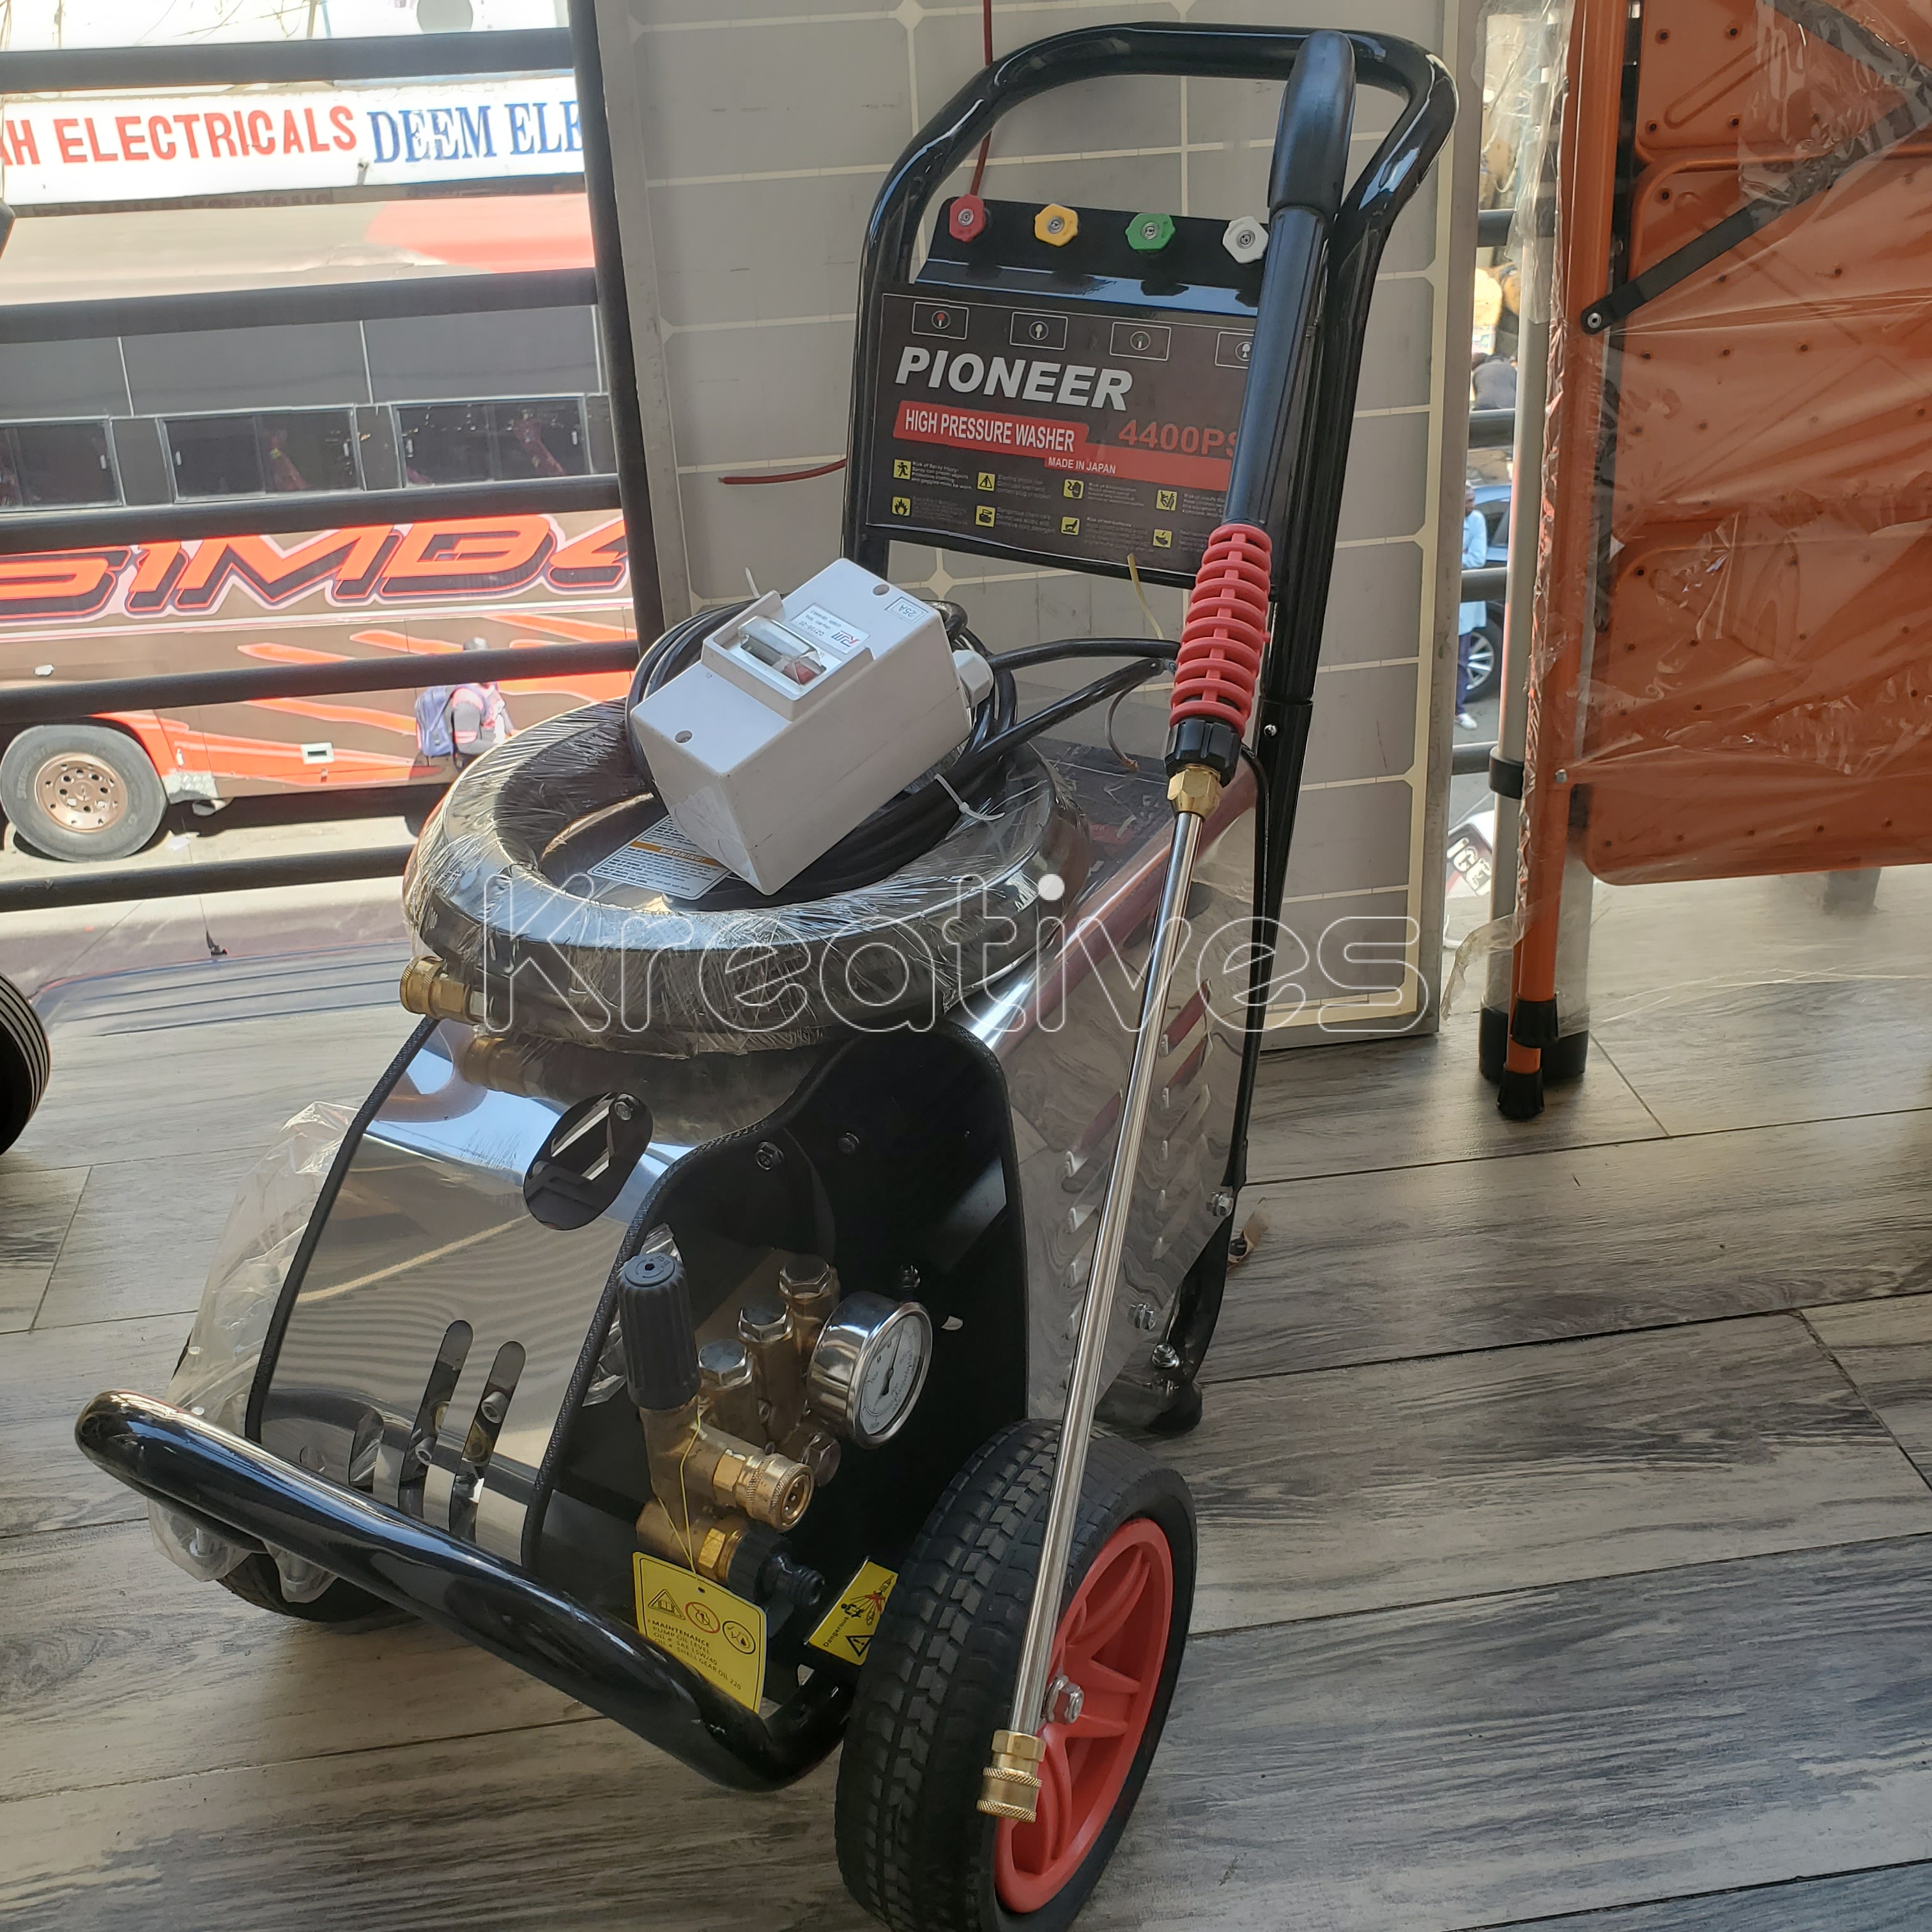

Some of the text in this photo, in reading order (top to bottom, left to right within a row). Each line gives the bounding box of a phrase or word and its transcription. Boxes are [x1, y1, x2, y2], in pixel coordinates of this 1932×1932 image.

[53, 105, 356, 164] ELECTRICALS
[367, 105, 497, 164] DEEM
[895, 346, 1133, 411] PIONEER
[905, 408, 1075, 452] HIGH PRESSURE WASHER
[1048, 456, 1116, 474] MADE IN JAPAN
[898, 604, 917, 617] 25A
[659, 848, 705, 862] WARNING!
[652, 1620, 710, 1648] MAINTENANCE
[653, 1626, 710, 1655] PUMP OIL LEVEL
[676, 1641, 689, 1650] SAE
[823, 1616, 849, 1648] Dangerous
[654, 1637, 666, 1646] OIL
[677, 1646, 698, 1661] SHELL
[698, 1658, 717, 1673] GEAR
[717, 1669, 729, 1681] OIL
[730, 1678, 742, 1690] 220
